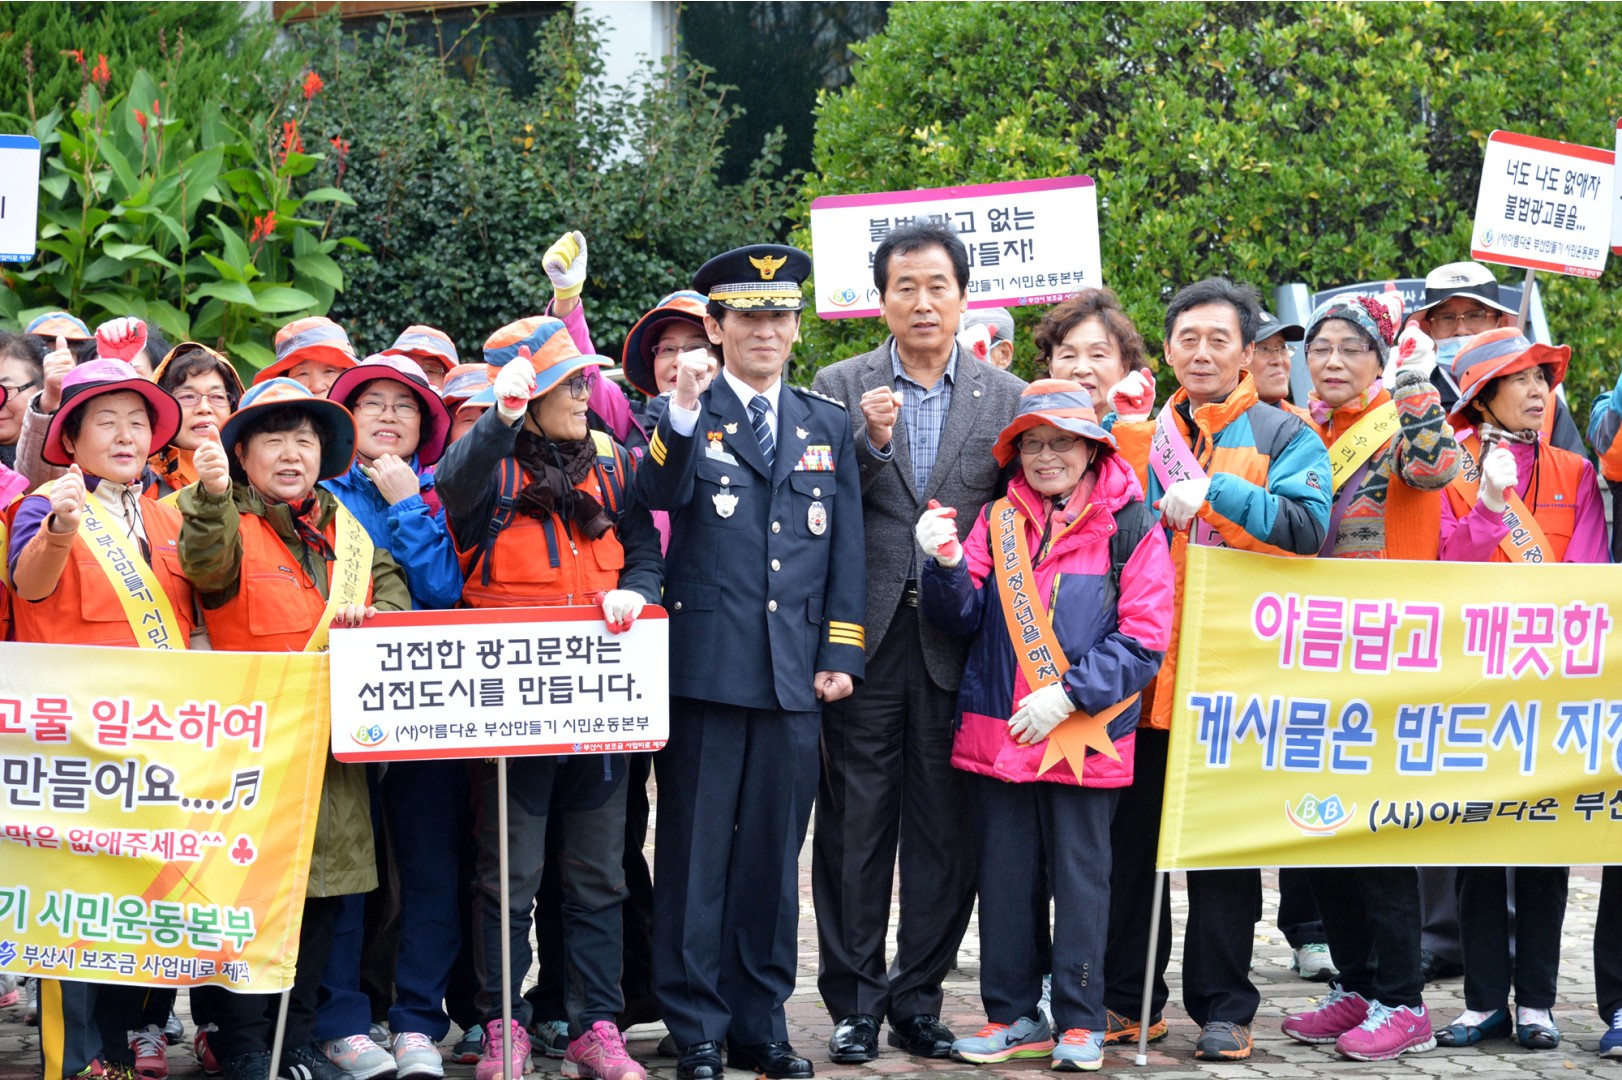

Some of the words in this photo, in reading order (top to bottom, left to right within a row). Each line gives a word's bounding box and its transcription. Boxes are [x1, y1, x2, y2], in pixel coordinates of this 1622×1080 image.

[1506, 159, 1531, 186] 너도
[1535, 165, 1560, 191] 나도
[1563, 170, 1601, 200] 없애자
[988, 206, 1035, 233] 없는
[1504, 194, 1586, 231] 불법광고물을...
[1564, 244, 1600, 261] 시민운동본부
[968, 278, 1005, 293] 만들기
[1009, 270, 1084, 291] 시민운동본부
[1503, 505, 1532, 547] 물은
[96, 534, 154, 603] 부산만들기
[1008, 571, 1041, 645] 청소년을
[1028, 645, 1060, 688] 해쳐
[1255, 593, 1441, 671] 아름답고
[1465, 604, 1608, 677] 깨끗한
[376, 638, 465, 671] 건전한
[476, 635, 622, 670] 광고문화는
[357, 678, 505, 711] 선전도시를
[518, 673, 642, 705] 만듭니다.
[92, 700, 263, 748] 일소하여
[395, 723, 478, 742] (사)아름다운
[484, 719, 556, 736] 부산만들기
[563, 716, 649, 733] 시민운동본부
[1190, 695, 1374, 771] 게시물은
[1397, 702, 1541, 773] 반드시
[583, 743, 603, 751] 부산시
[604, 742, 624, 750] 보조금
[625, 741, 651, 750] 사업비로
[3, 757, 215, 810] 만들어요...
[1369, 797, 1559, 832] (사)아름다운
[0, 823, 59, 849] 막은
[40, 893, 255, 950] 시민운동본부
[23, 945, 74, 970] 부산시
[80, 951, 137, 974] 보조금
[142, 955, 216, 979] 사업비로
[222, 960, 251, 983] 제작
